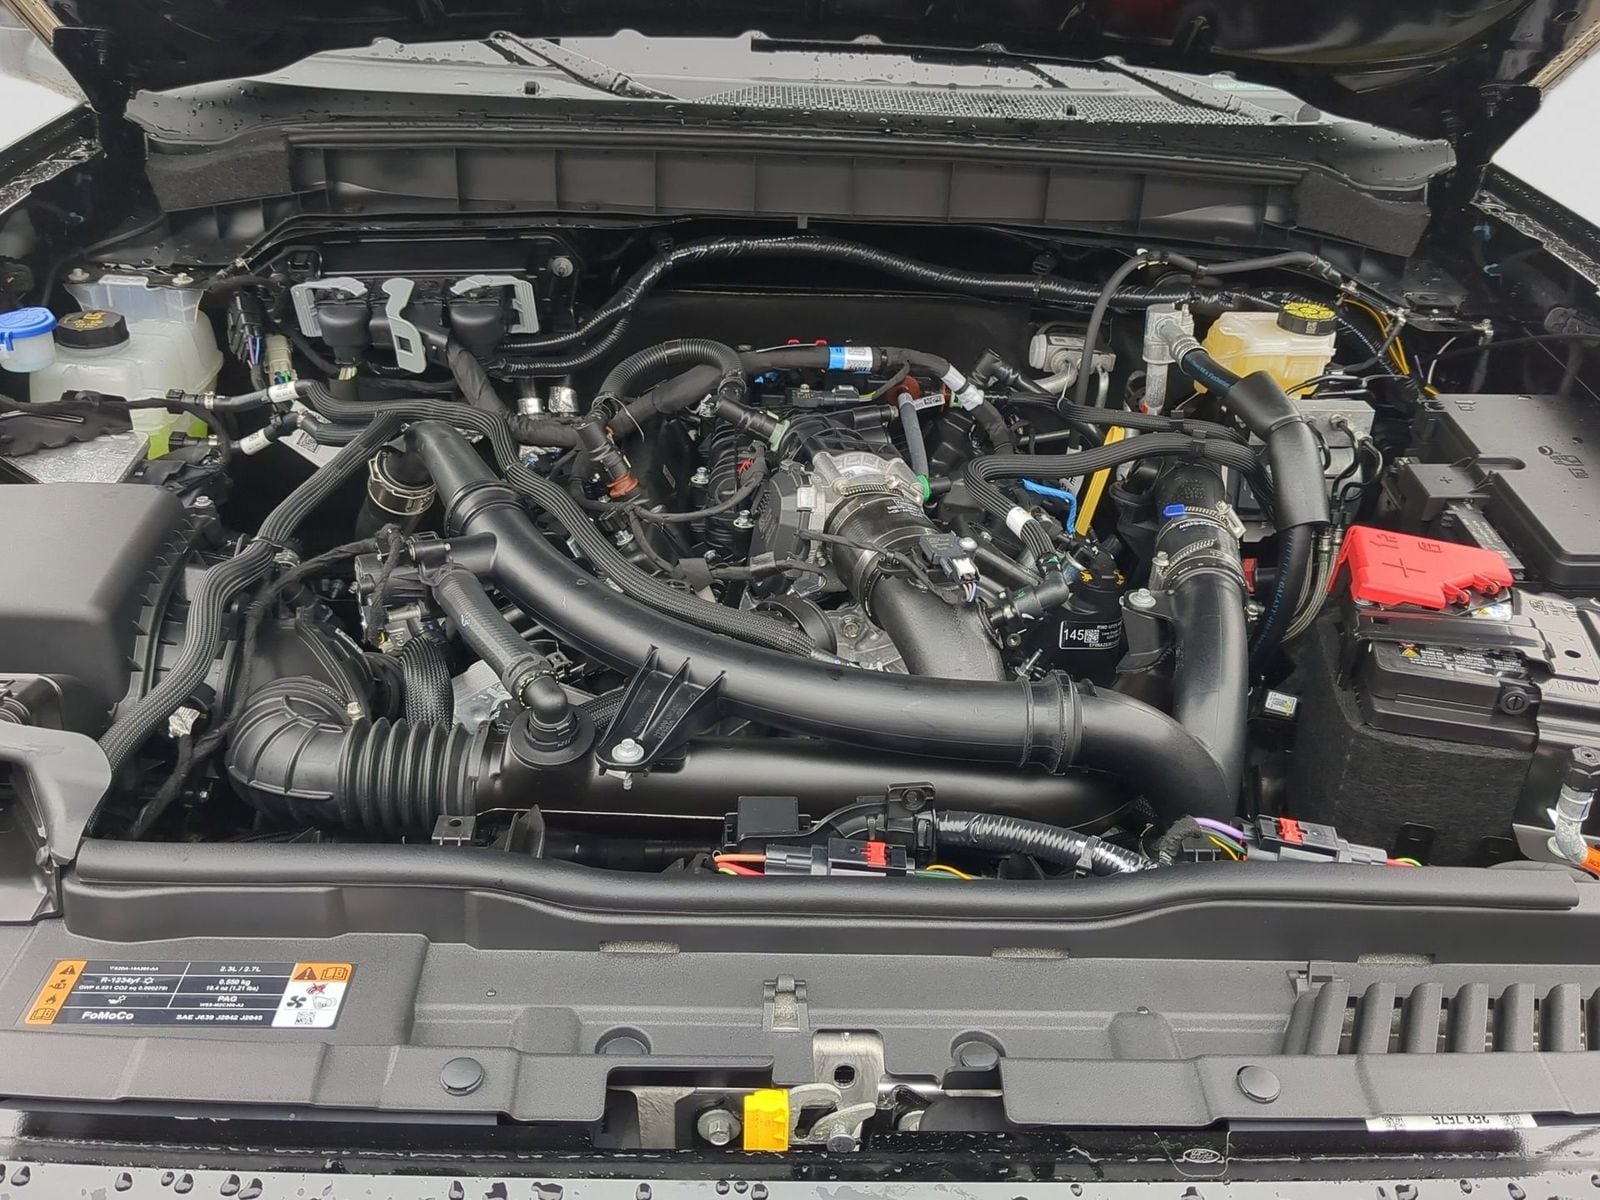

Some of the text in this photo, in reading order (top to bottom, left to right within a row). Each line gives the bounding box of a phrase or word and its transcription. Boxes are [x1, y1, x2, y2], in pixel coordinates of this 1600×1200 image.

[1063, 629, 1085, 641] 145
[100, 976, 141, 985] R-1234yf
[241, 979, 252, 987] kg
[81, 1010, 135, 1020] FoMoCo
